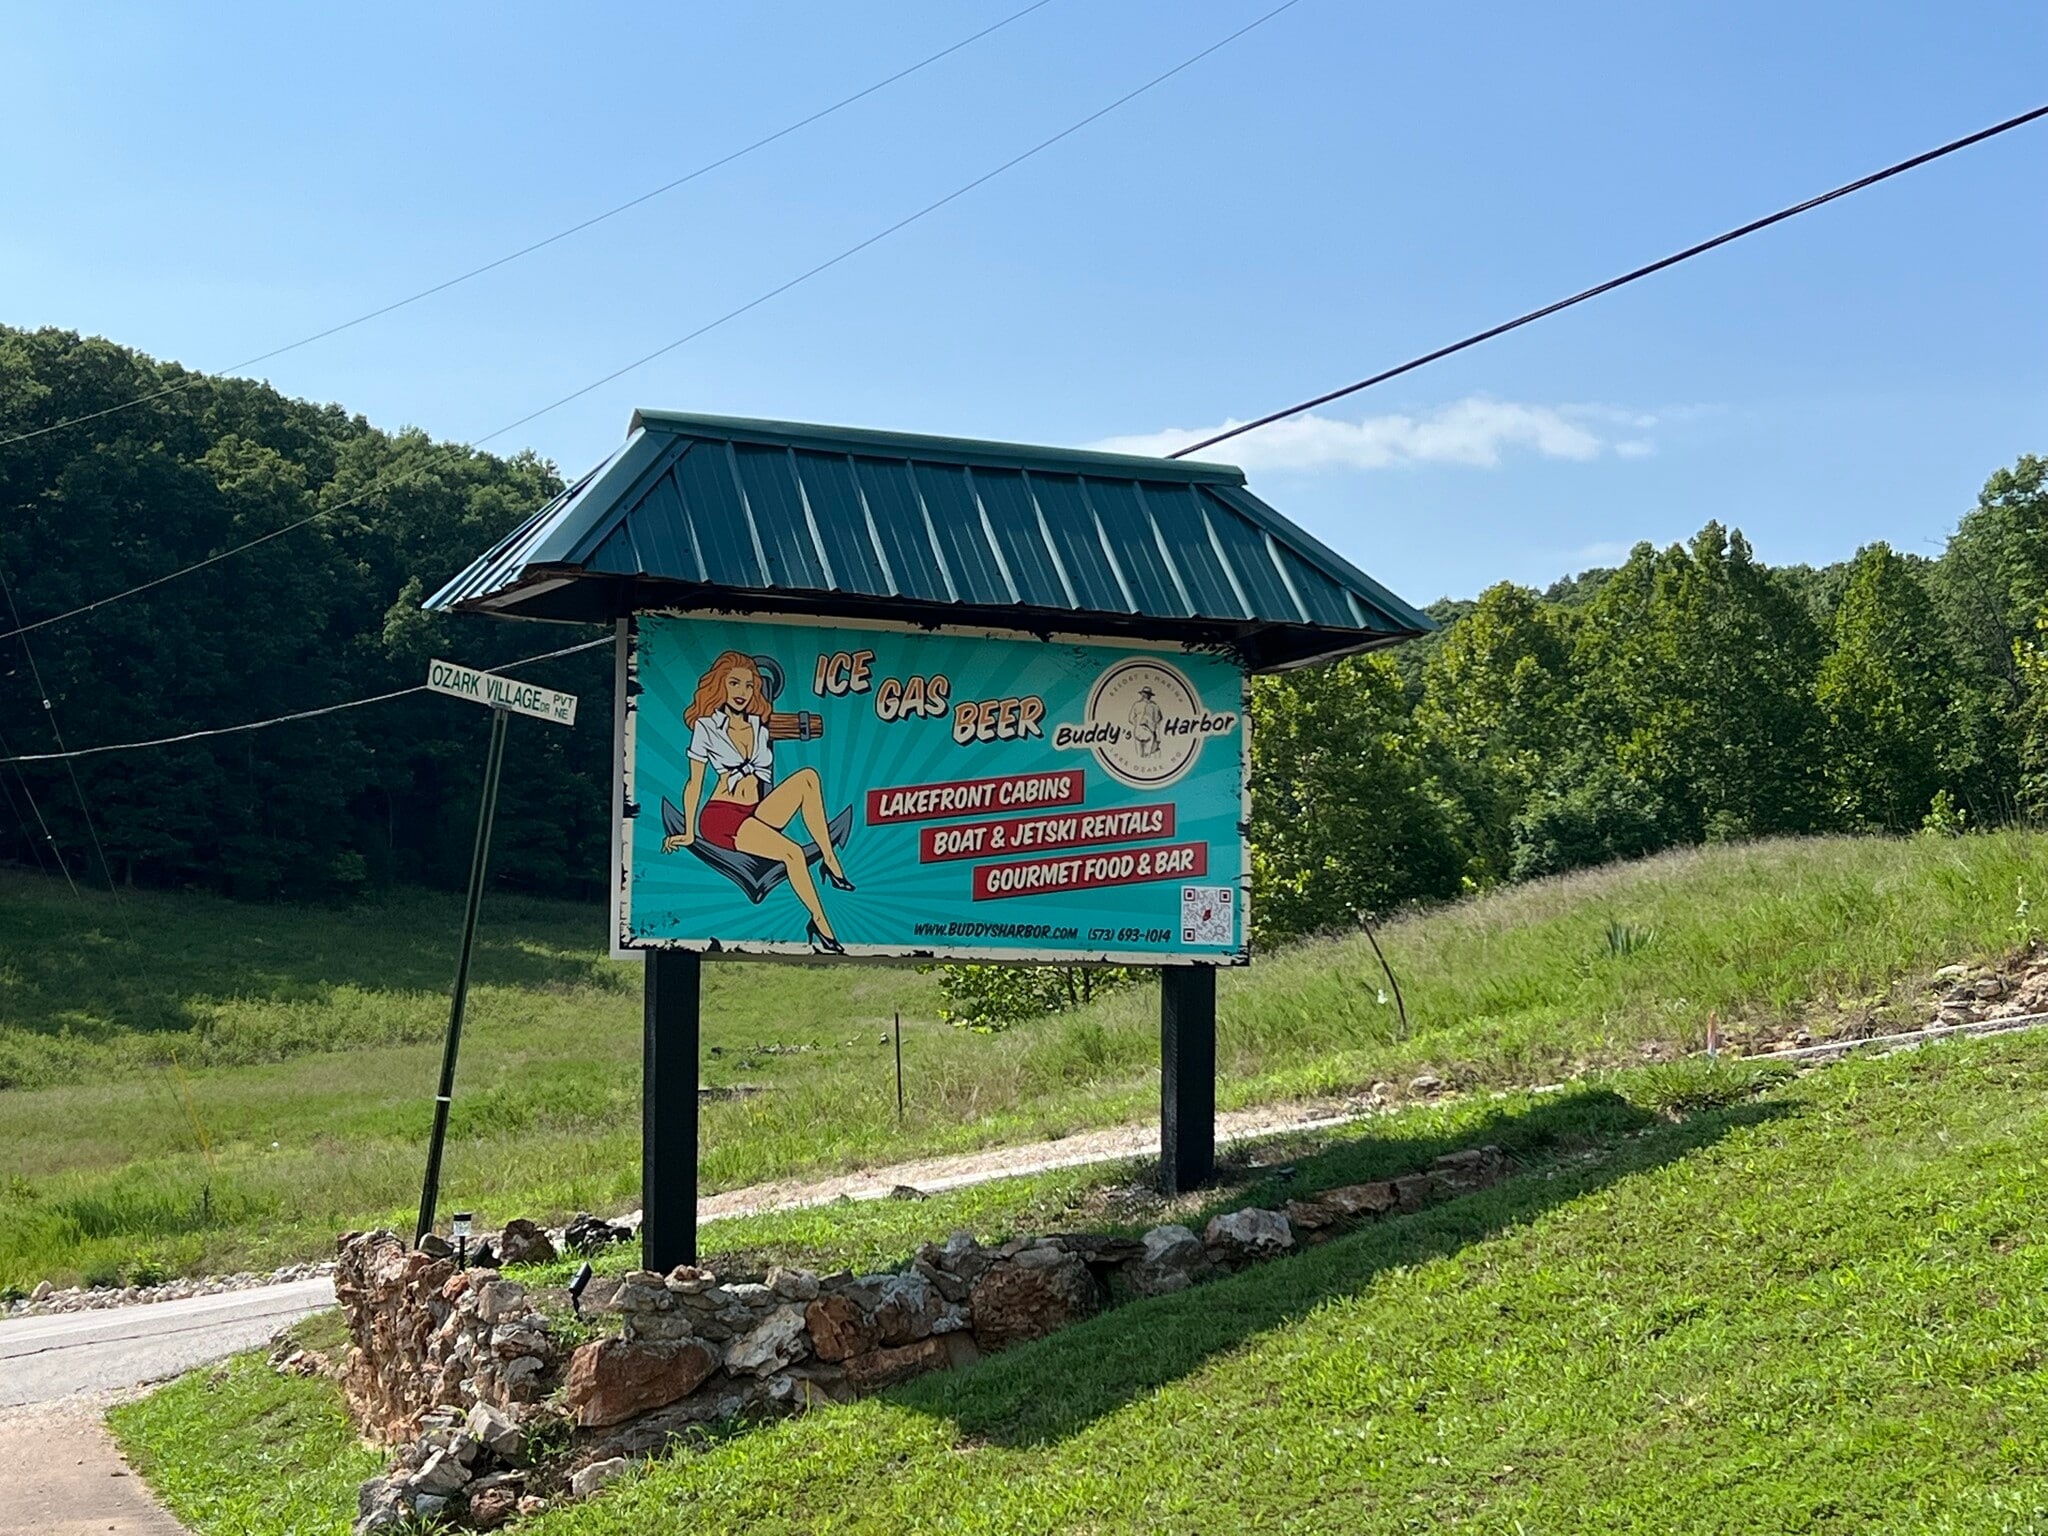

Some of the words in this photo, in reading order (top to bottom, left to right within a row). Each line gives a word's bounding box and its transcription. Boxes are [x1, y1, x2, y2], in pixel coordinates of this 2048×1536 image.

[432, 665, 481, 696] OZARK
[487, 678, 542, 711] VILLAGE
[539, 702, 550, 713] DR
[812, 650, 876, 697] ICE
[553, 694, 574, 709] PVT
[554, 708, 568, 720] NE
[875, 675, 951, 722] GAS
[952, 697, 1046, 745] BEER
[1056, 721, 1132, 746] Buddy's
[1164, 713, 1235, 736] Harbor
[879, 784, 996, 817] LAKEFRONT
[1000, 776, 1071, 804] CABINS
[933, 828, 987, 855] BOAT
[993, 827, 1006, 849] &
[1010, 819, 1076, 847] JETSKI
[1081, 810, 1163, 837] RENTALS
[986, 862, 1083, 893] GOURMET
[1084, 856, 1134, 882] FOOD
[1137, 853, 1152, 874] &
[1155, 848, 1194, 872] BAR
[914, 922, 1078, 939] WWW.BUDDYSHARBOR.COM
[1087, 927, 1115, 941] (573)
[1117, 927, 1171, 942] 693-1014
